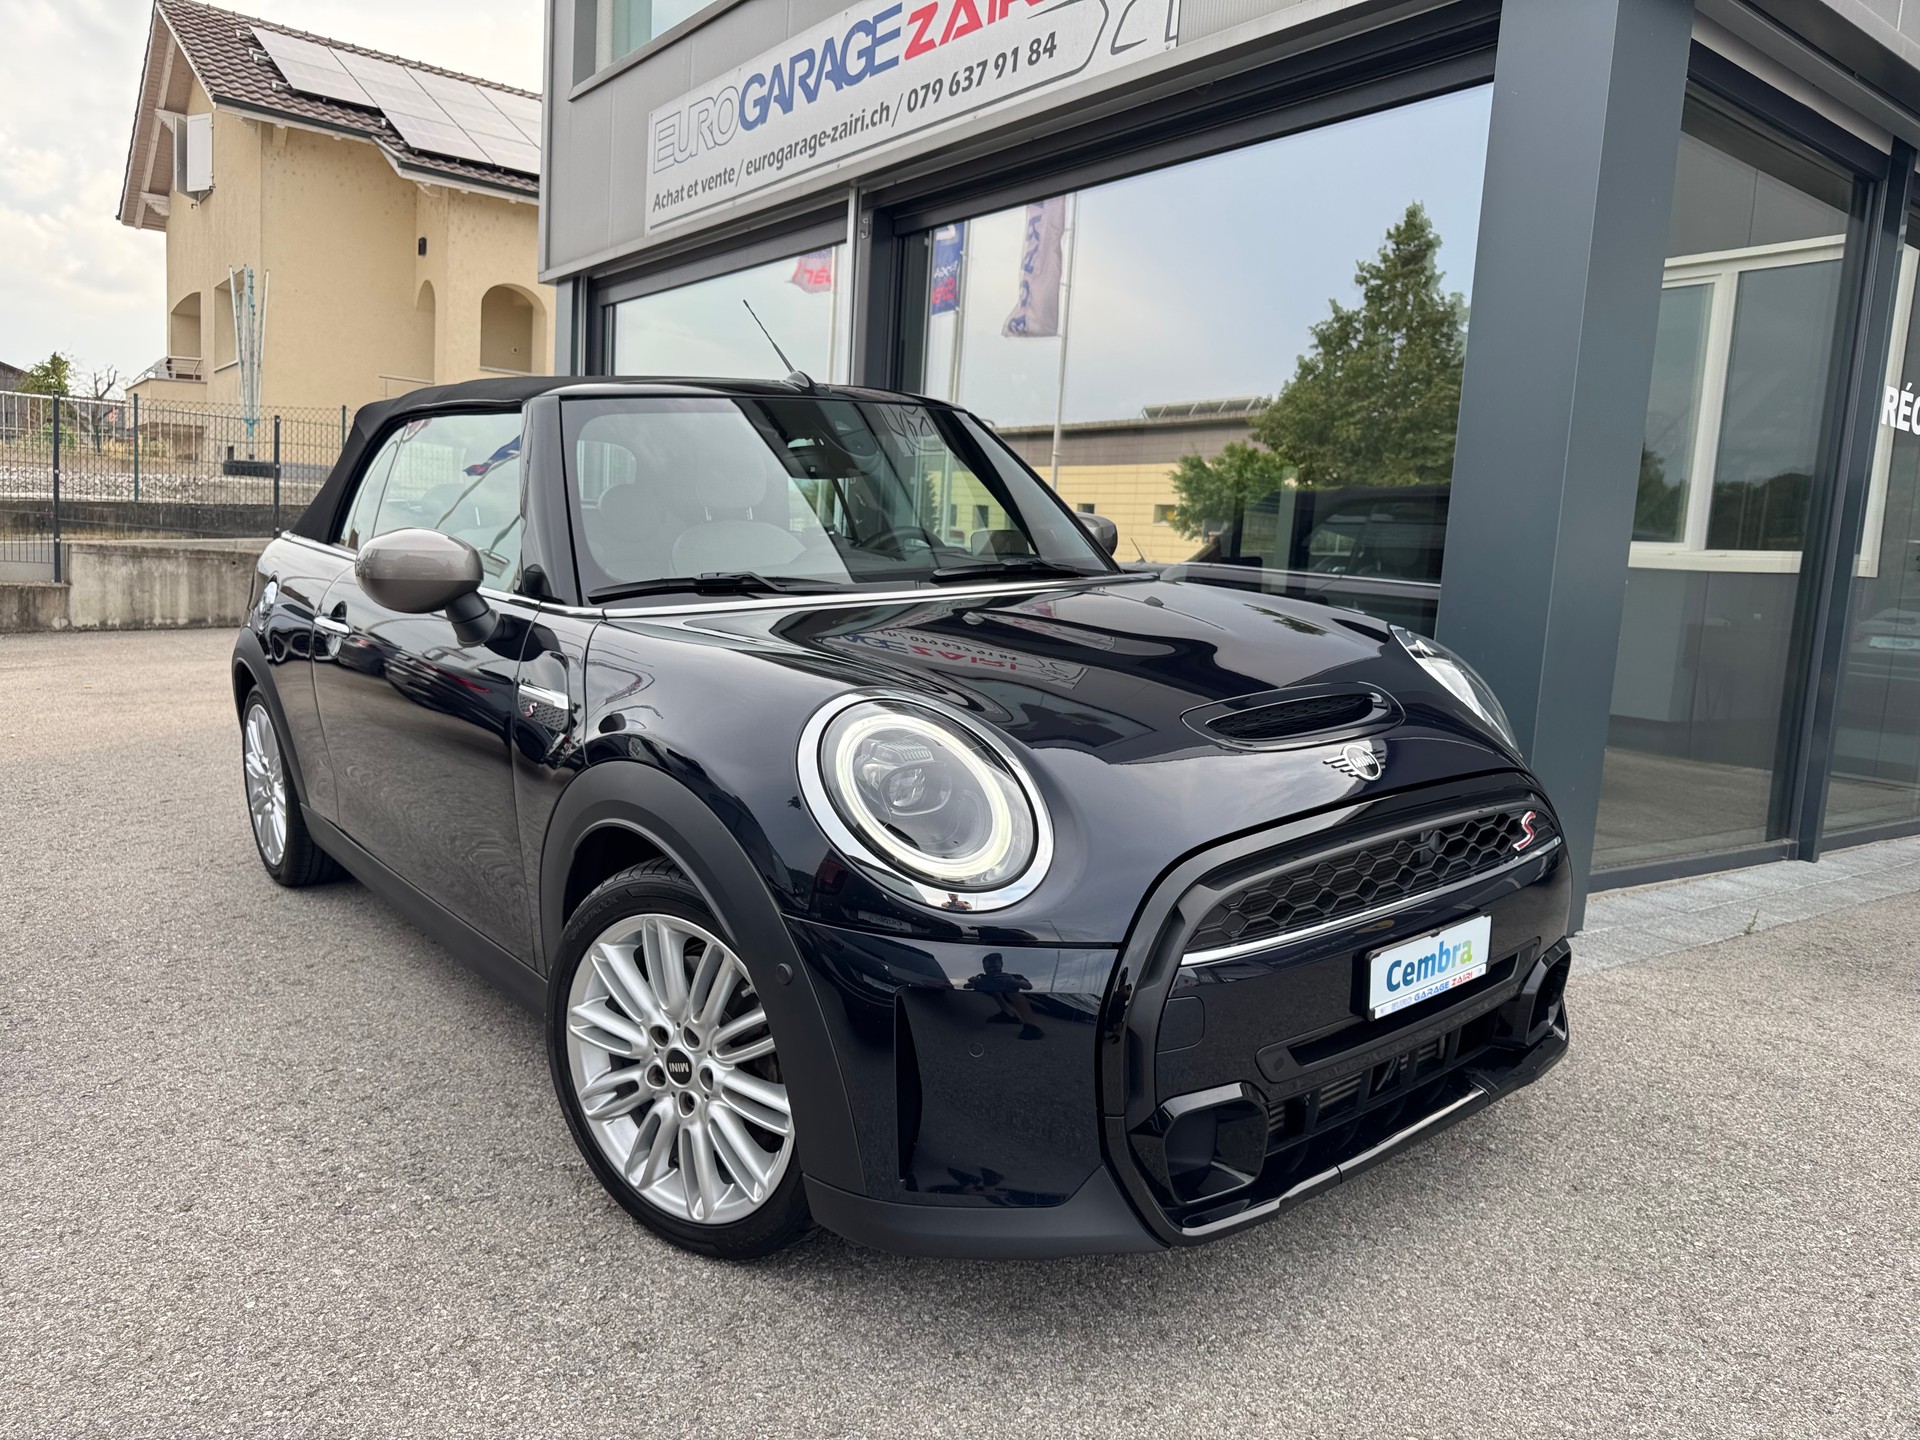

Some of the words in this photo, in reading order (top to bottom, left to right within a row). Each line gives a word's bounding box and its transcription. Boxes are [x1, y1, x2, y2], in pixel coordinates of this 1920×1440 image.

[652, 185, 685, 212] Achat
[686, 180, 699, 198] et
[701, 166, 736, 193] vente
[745, 101, 890, 176] eurogarage-zairi.ch
[906, 78, 944, 114] 079
[948, 59, 989, 97] 637
[994, 46, 1020, 80] 91
[1027, 31, 1058, 67] 84
[1350, 754, 1376, 768] MINI
[1513, 811, 1537, 851] S
[1386, 939, 1473, 993] Cembra
[1414, 980, 1450, 1001] GARAGE
[1451, 971, 1473, 986] ZAIRI
[668, 1062, 690, 1073] MINI
